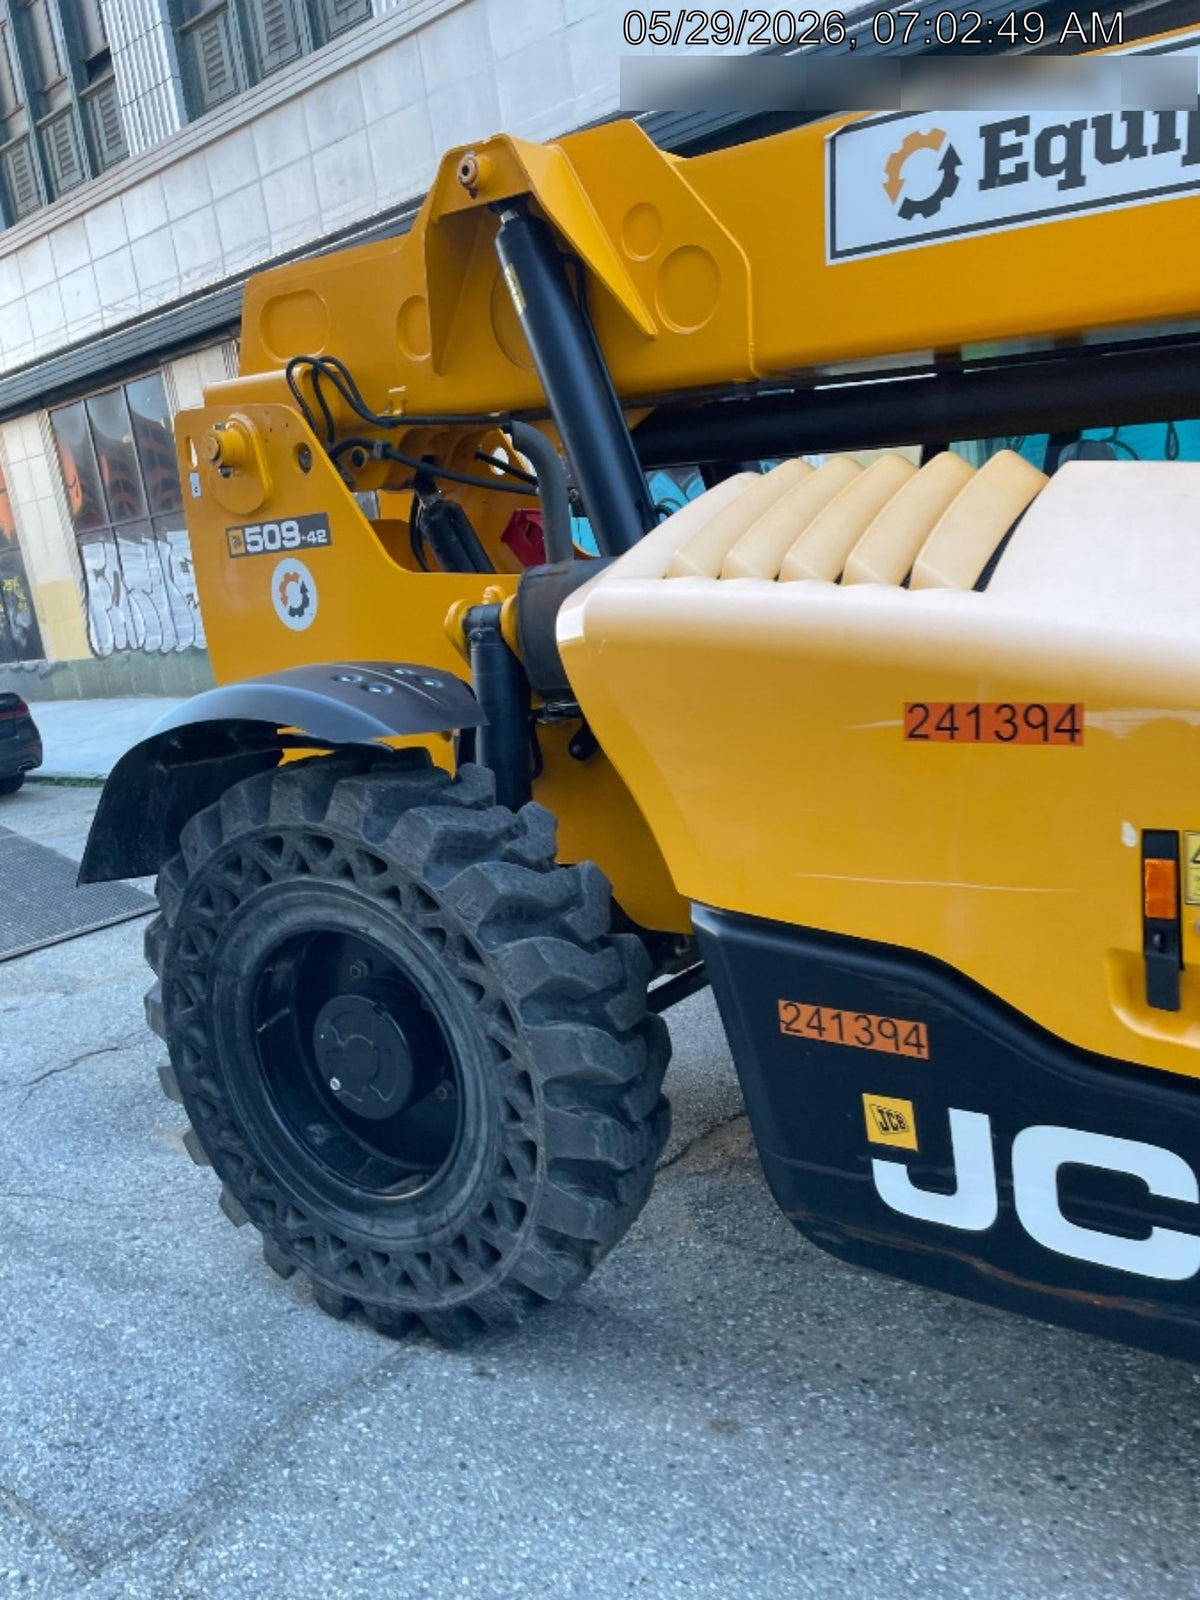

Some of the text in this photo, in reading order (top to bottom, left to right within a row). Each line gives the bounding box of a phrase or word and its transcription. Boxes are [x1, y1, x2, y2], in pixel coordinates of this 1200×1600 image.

[907, 703, 1080, 742] 241394
[783, 1003, 925, 1055] 241394
[876, 1108, 907, 1132] JCB
